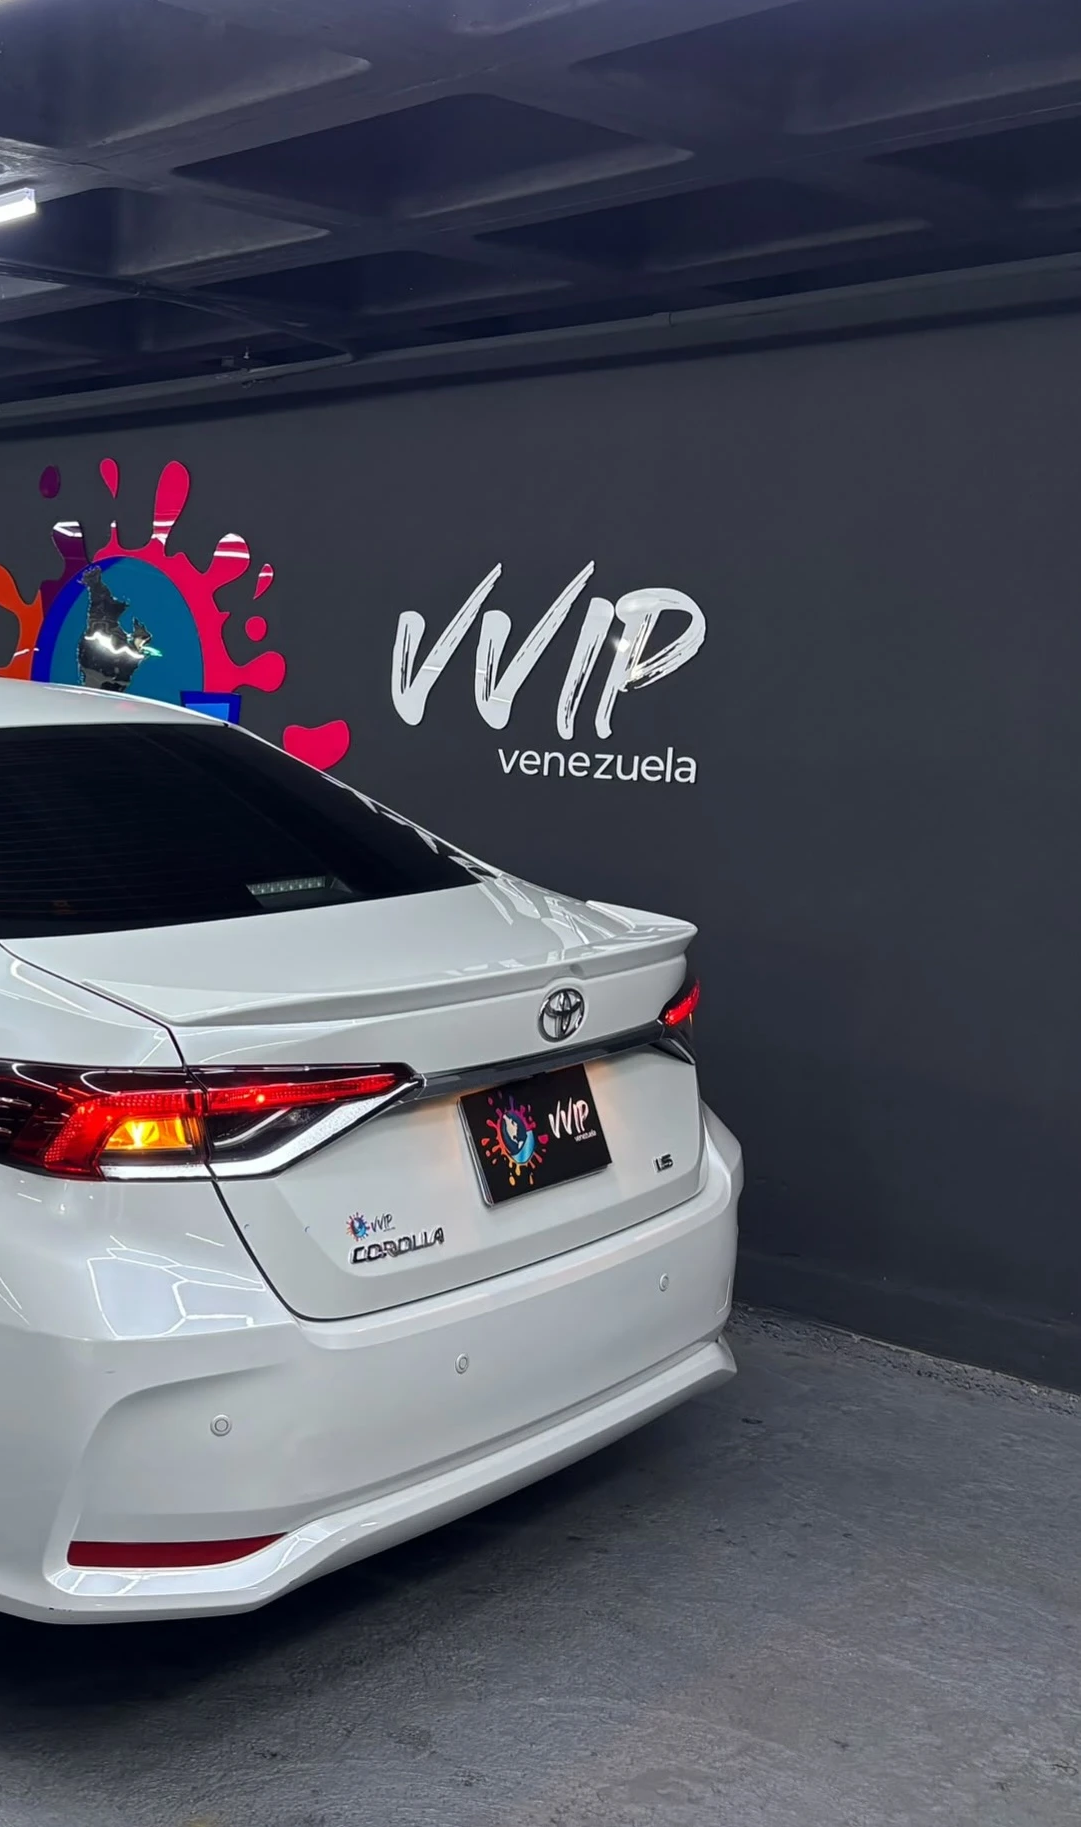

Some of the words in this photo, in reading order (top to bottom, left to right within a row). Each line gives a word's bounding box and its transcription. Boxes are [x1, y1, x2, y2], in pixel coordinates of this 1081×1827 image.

[391, 560, 706, 740] VVIP
[497, 747, 697, 783] venezuela
[548, 1096, 589, 1139] VVIP
[350, 1226, 445, 1264] COROLLA
